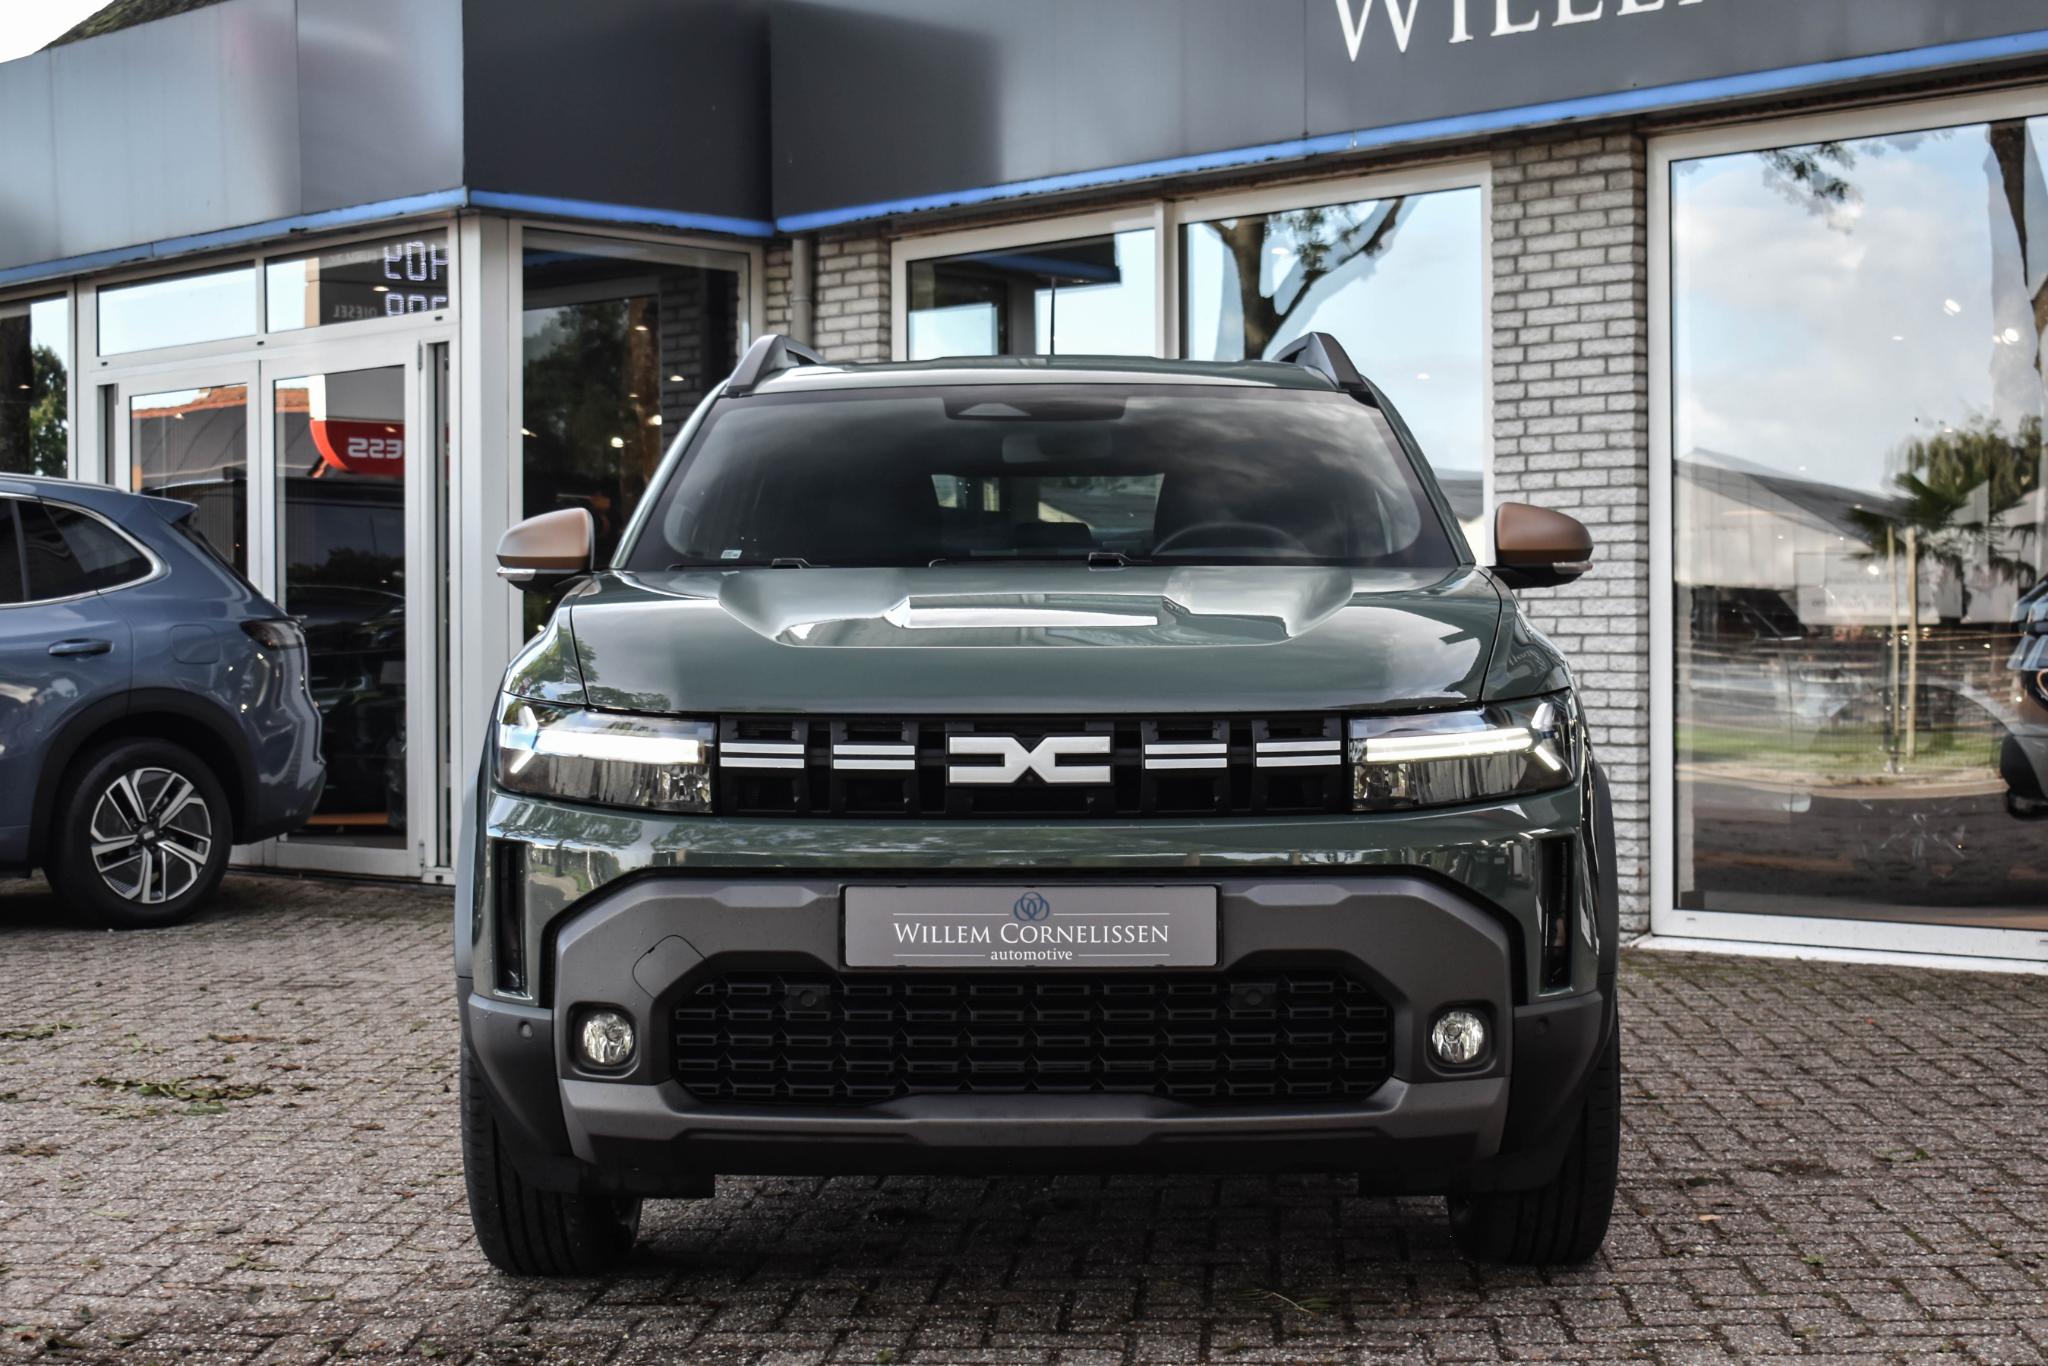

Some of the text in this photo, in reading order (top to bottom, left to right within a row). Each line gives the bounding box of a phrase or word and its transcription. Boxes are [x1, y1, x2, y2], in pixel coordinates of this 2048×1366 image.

[893, 922, 1170, 945] WILLEM CORNELISSEN
[990, 947, 1073, 961] automotive
